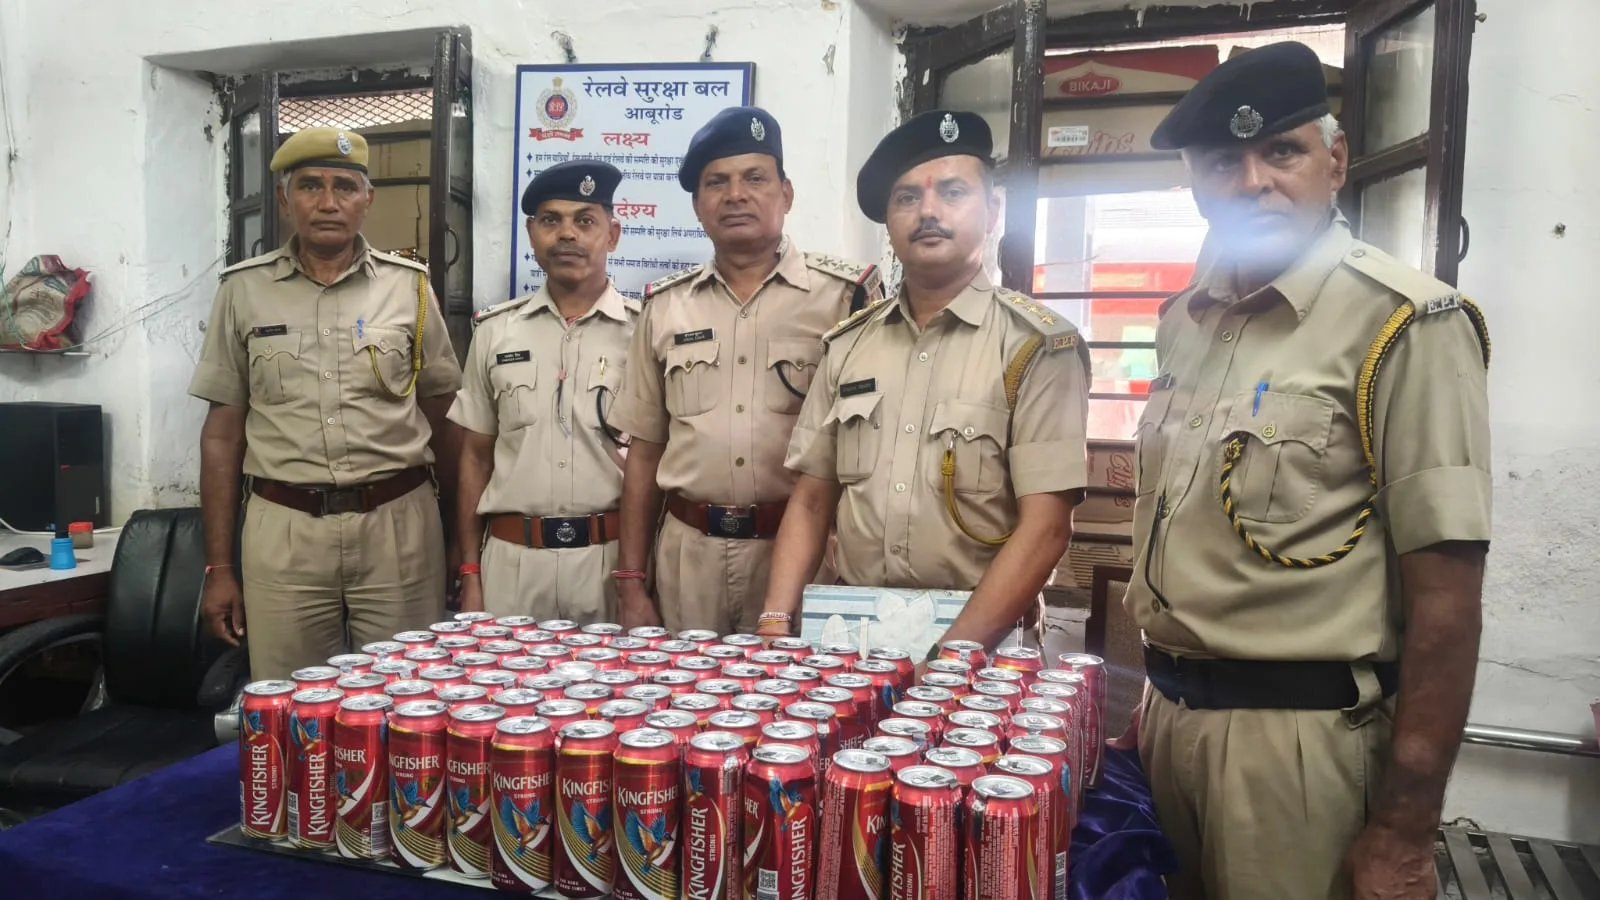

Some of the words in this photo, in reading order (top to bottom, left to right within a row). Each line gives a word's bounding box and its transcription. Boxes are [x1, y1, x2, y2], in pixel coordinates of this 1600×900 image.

[583, 76, 629, 98] रेलवे
[632, 81, 689, 103] सुरक्षा
[693, 81, 730, 97] बल
[1069, 79, 1111, 92] BIKAJI
[625, 103, 685, 125] आबूरोड
[601, 132, 651, 149] लक्ष्य
[613, 197, 657, 219] देश्य
[334, 745, 366, 764] FISHER
[388, 752, 440, 770] NGFISHER
[447, 759, 492, 776] GFISHER
[251, 743, 272, 825] KINGFISHER
[493, 770, 552, 792] KINGFISHE
[307, 751, 330, 836] KINGFISHER
[618, 784, 679, 808] KINGFISHE
[688, 807, 709, 900] KINGFISHER
[791, 815, 808, 900] INGFISHER
[892, 842, 906, 900] FISHER
